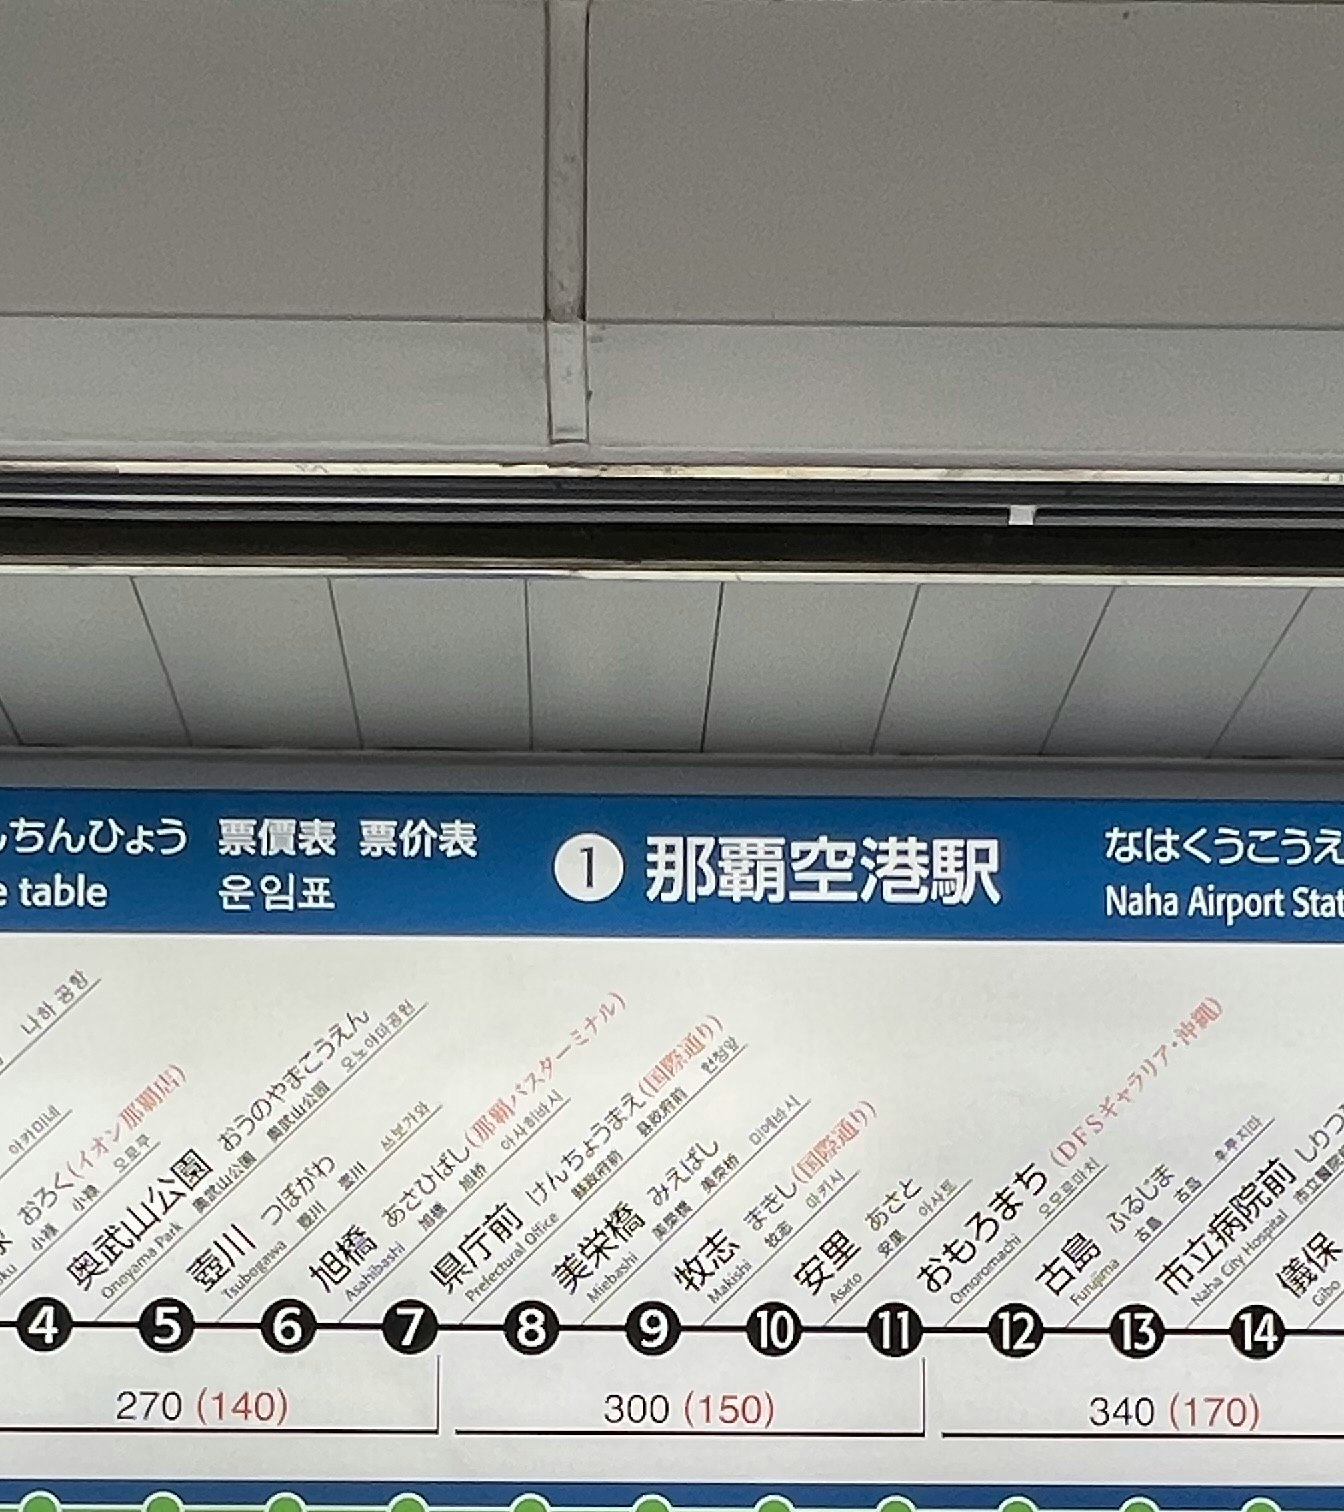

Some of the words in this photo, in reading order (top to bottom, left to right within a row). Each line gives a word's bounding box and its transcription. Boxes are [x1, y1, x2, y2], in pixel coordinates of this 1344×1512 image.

[218, 817, 337, 859] 票價表
[359, 818, 478, 859] 票价表
[645, 835, 1004, 907] 那覇空港駅
[18, 875, 108, 909] table
[218, 873, 336, 912] 운임표
[1105, 883, 1179, 918] Naha
[1187, 884, 1285, 927] Airport
[260, 1154, 337, 1228] つぼがわ
[550, 1200, 648, 1297] 美栄橋
[645, 1135, 720, 1208] みえばし
[308, 1223, 380, 1294] 旭橋
[429, 1201, 525, 1296] 県庁前
[916, 1161, 1049, 1294] おもろまち
[1154, 1155, 1299, 1297] 市立病院前
[672, 1227, 742, 1294] 牧志
[792, 1228, 863, 1296] 安里
[1035, 1230, 1103, 1297] 古島
[116, 1390, 183, 1423] 270
[196, 1388, 289, 1426] (140)
[603, 1393, 670, 1426] 300
[683, 1391, 775, 1428] (150)
[1089, 1396, 1156, 1428] 340
[1168, 1394, 1261, 1432] (170)
